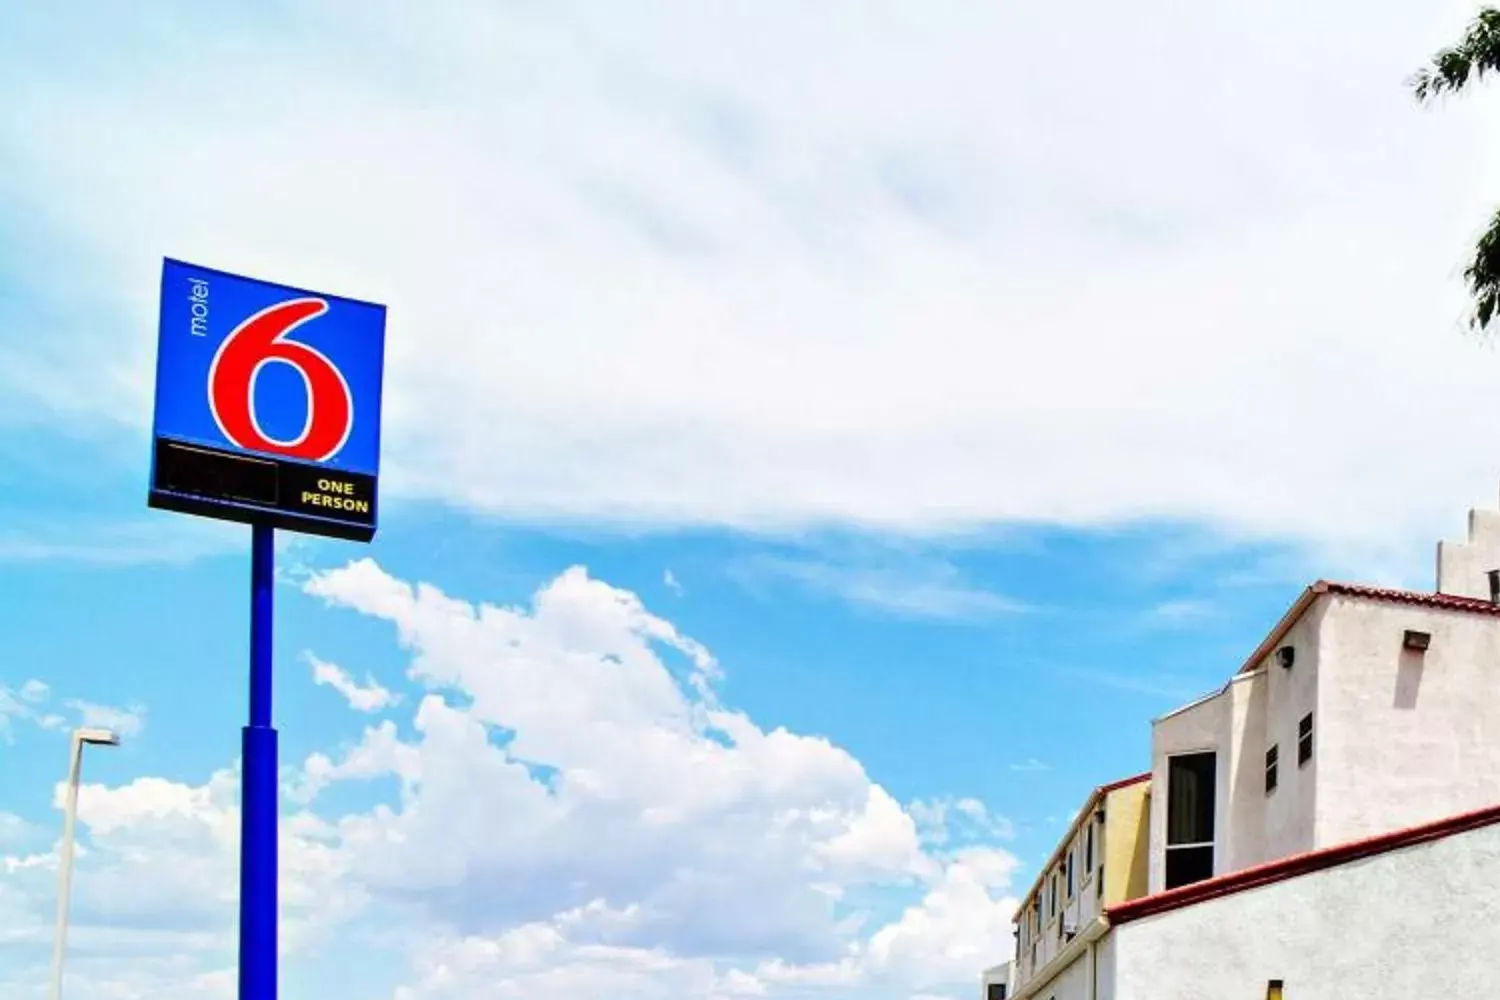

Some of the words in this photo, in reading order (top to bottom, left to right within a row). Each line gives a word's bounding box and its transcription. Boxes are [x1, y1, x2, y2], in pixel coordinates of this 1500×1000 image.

[187, 277, 209, 337] motel
[207, 297, 353, 462] 6
[301, 491, 369, 514] PERSON
[317, 478, 356, 496] ONE
